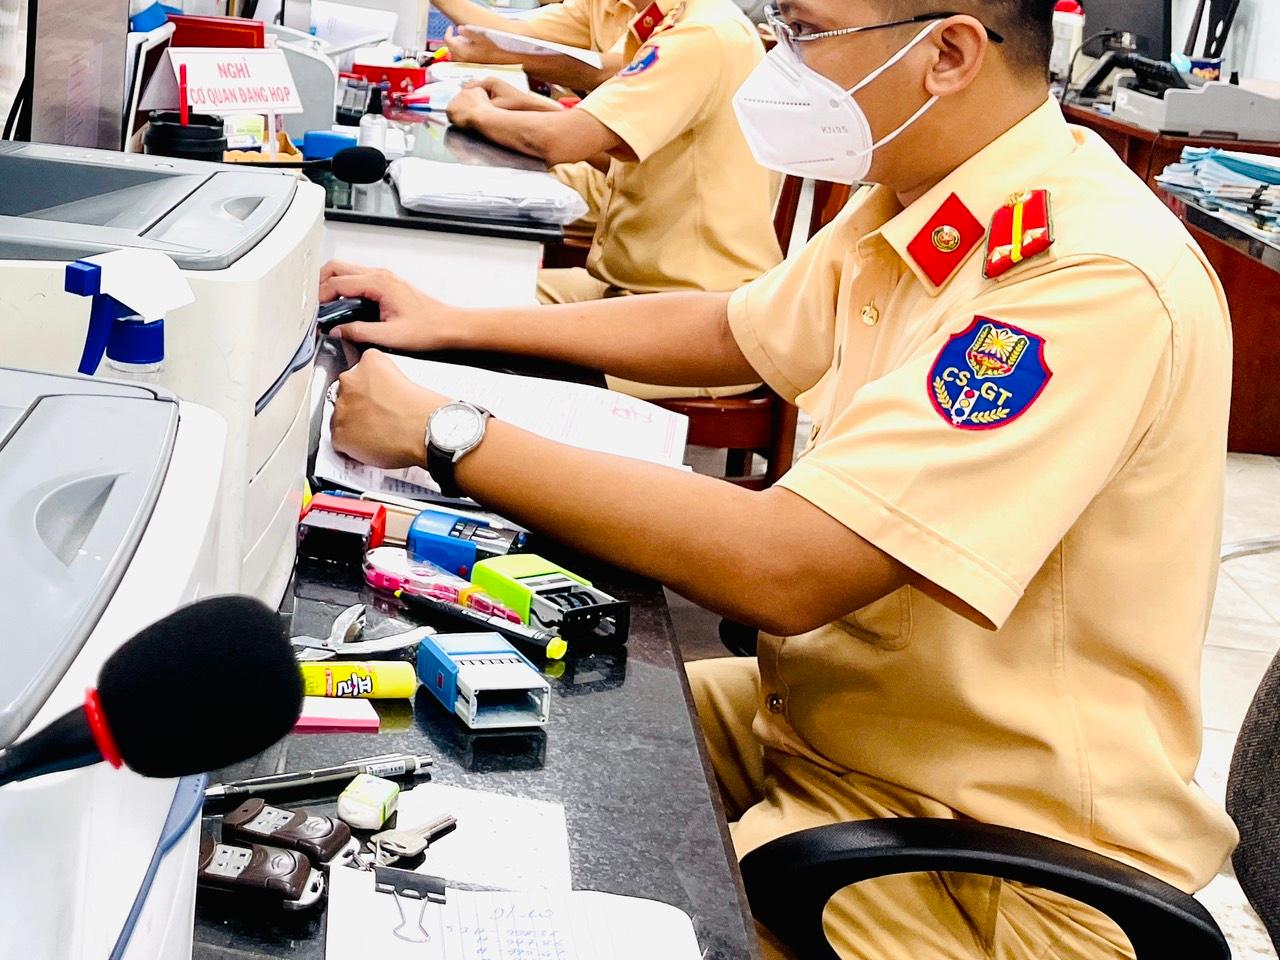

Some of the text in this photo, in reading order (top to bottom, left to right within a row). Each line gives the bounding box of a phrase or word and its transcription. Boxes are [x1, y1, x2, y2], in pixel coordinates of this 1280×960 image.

[207, 87, 238, 106] QUAN
[942, 366, 1013, 406] CS GT
